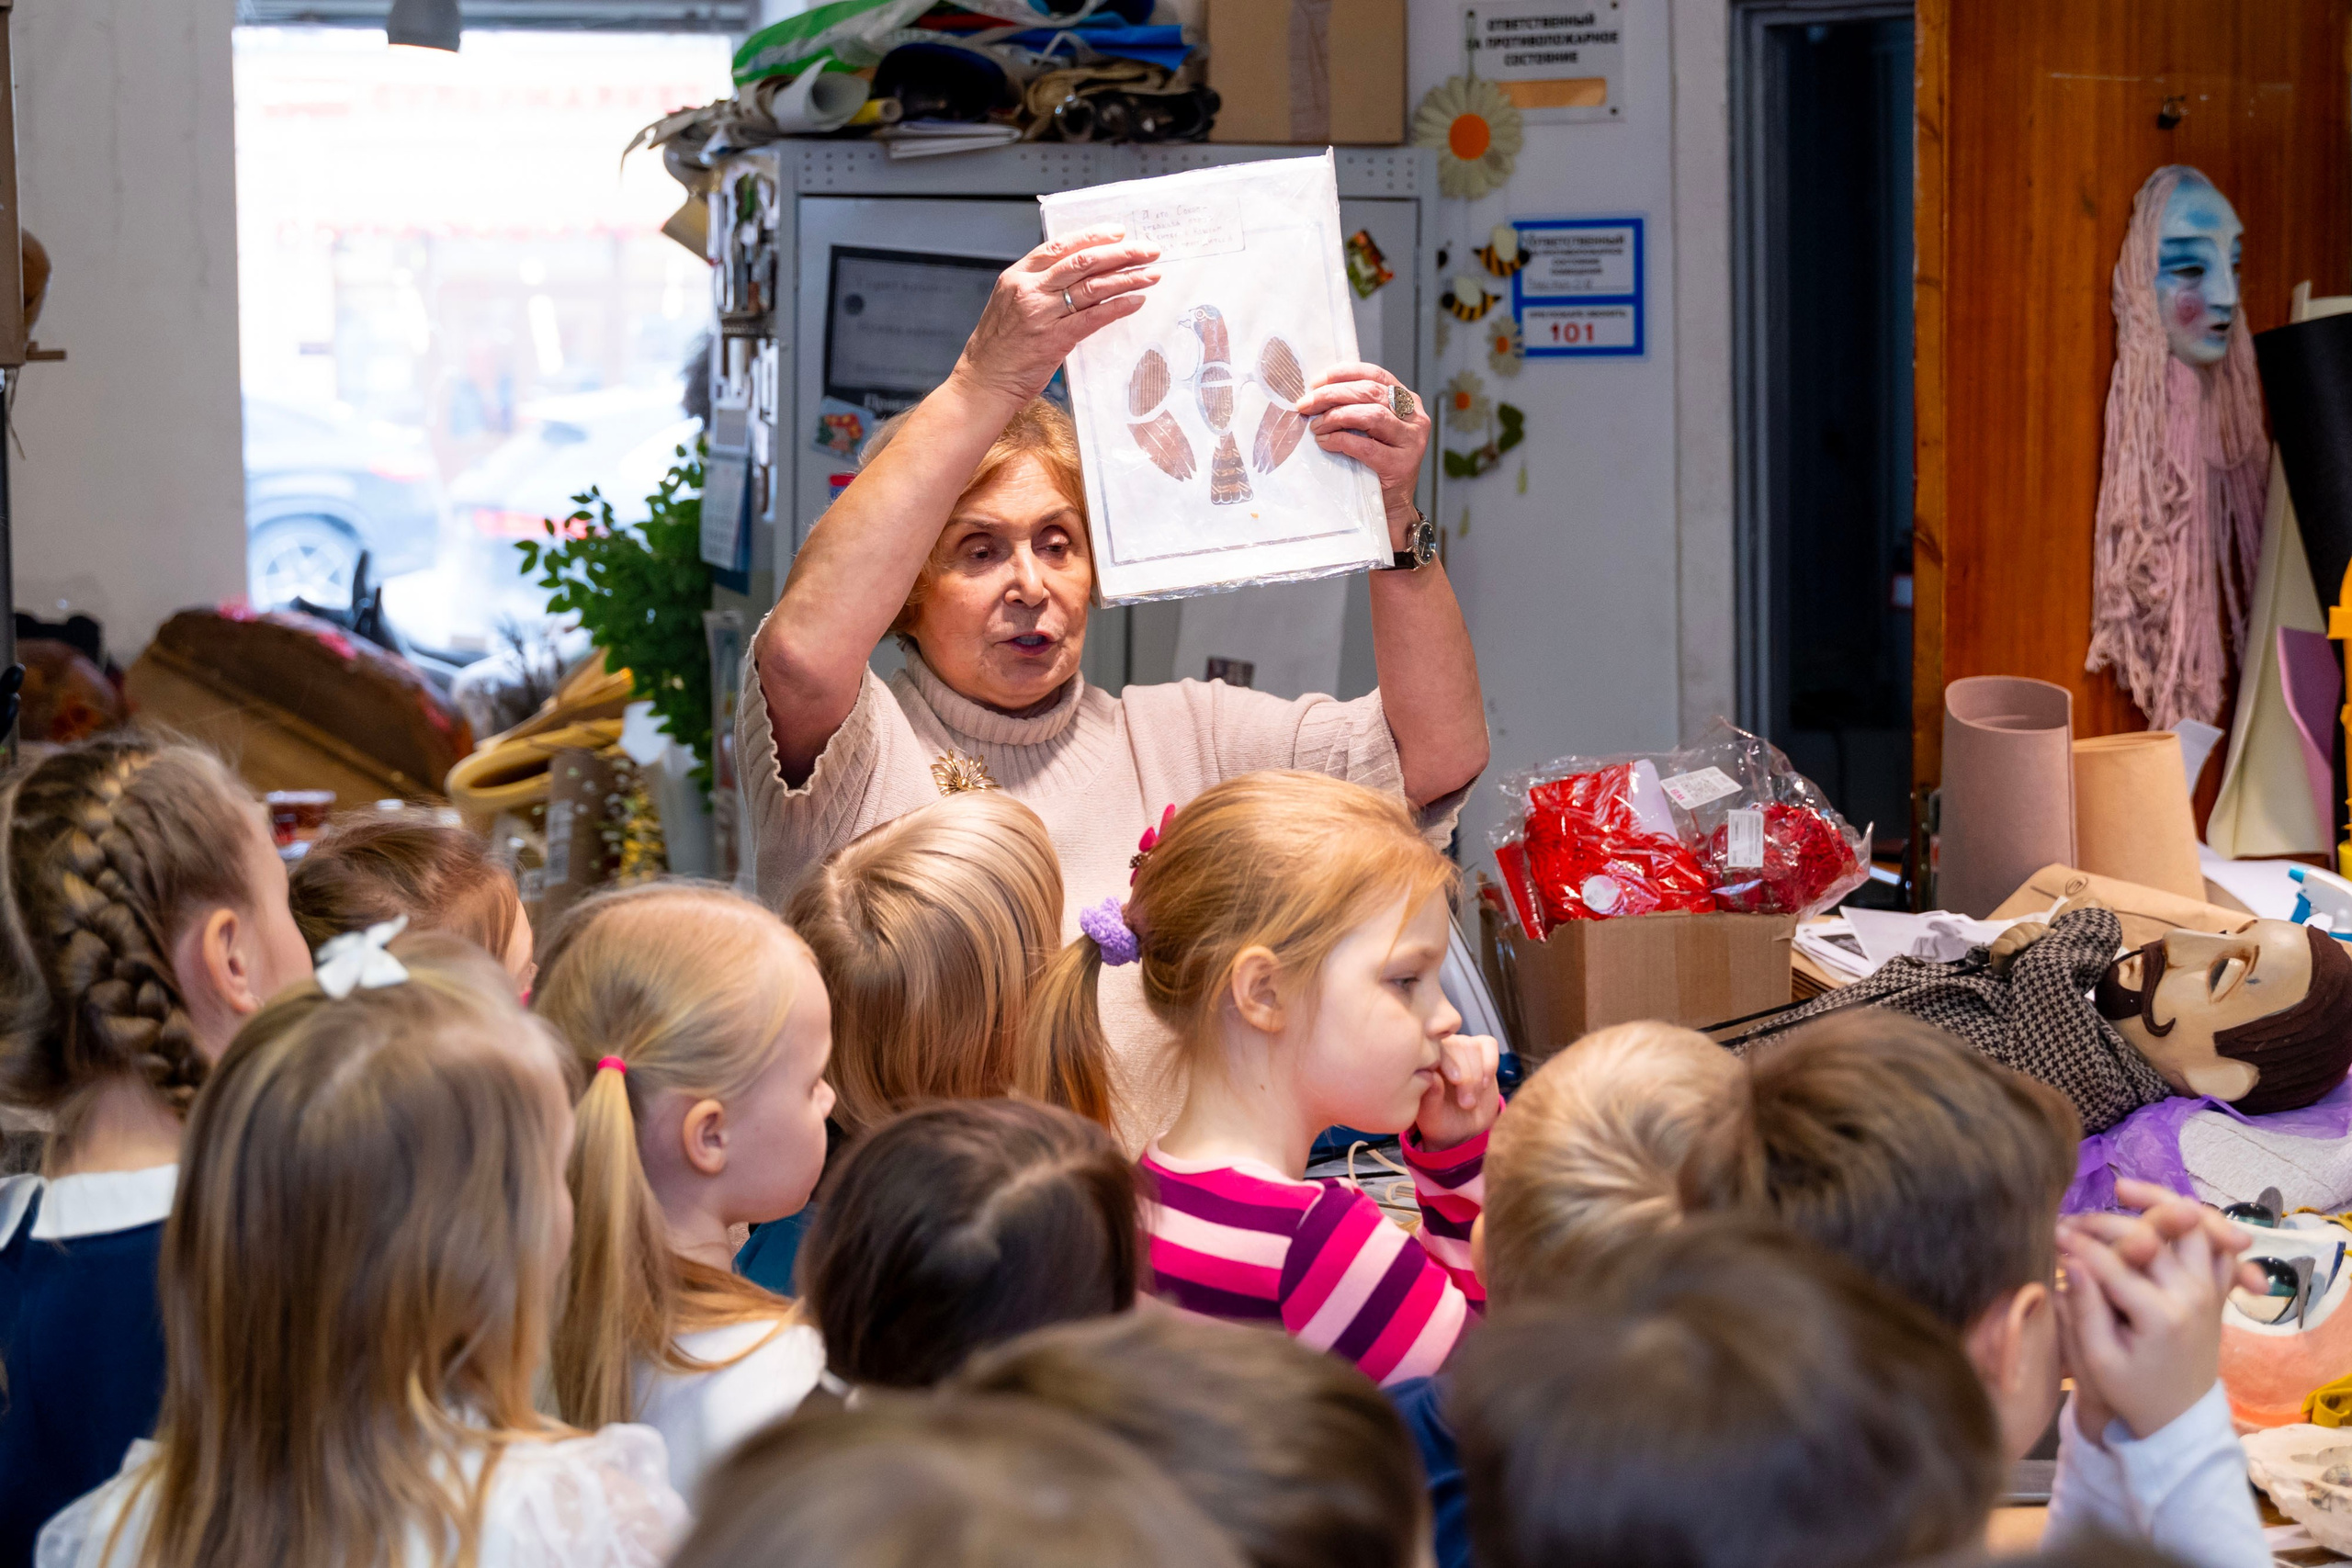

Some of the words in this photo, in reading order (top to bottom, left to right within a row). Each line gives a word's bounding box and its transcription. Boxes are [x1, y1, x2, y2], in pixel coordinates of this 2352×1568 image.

[1487, 14, 1595, 31] ОТВЕТСТВЕННЫЙ
[1486, 32, 1618, 49] ПРОТИВОПОЖАРНОЕ
[1504, 51, 1578, 66] СОСТОЯНИЕ
[1551, 323, 1594, 343] 101
